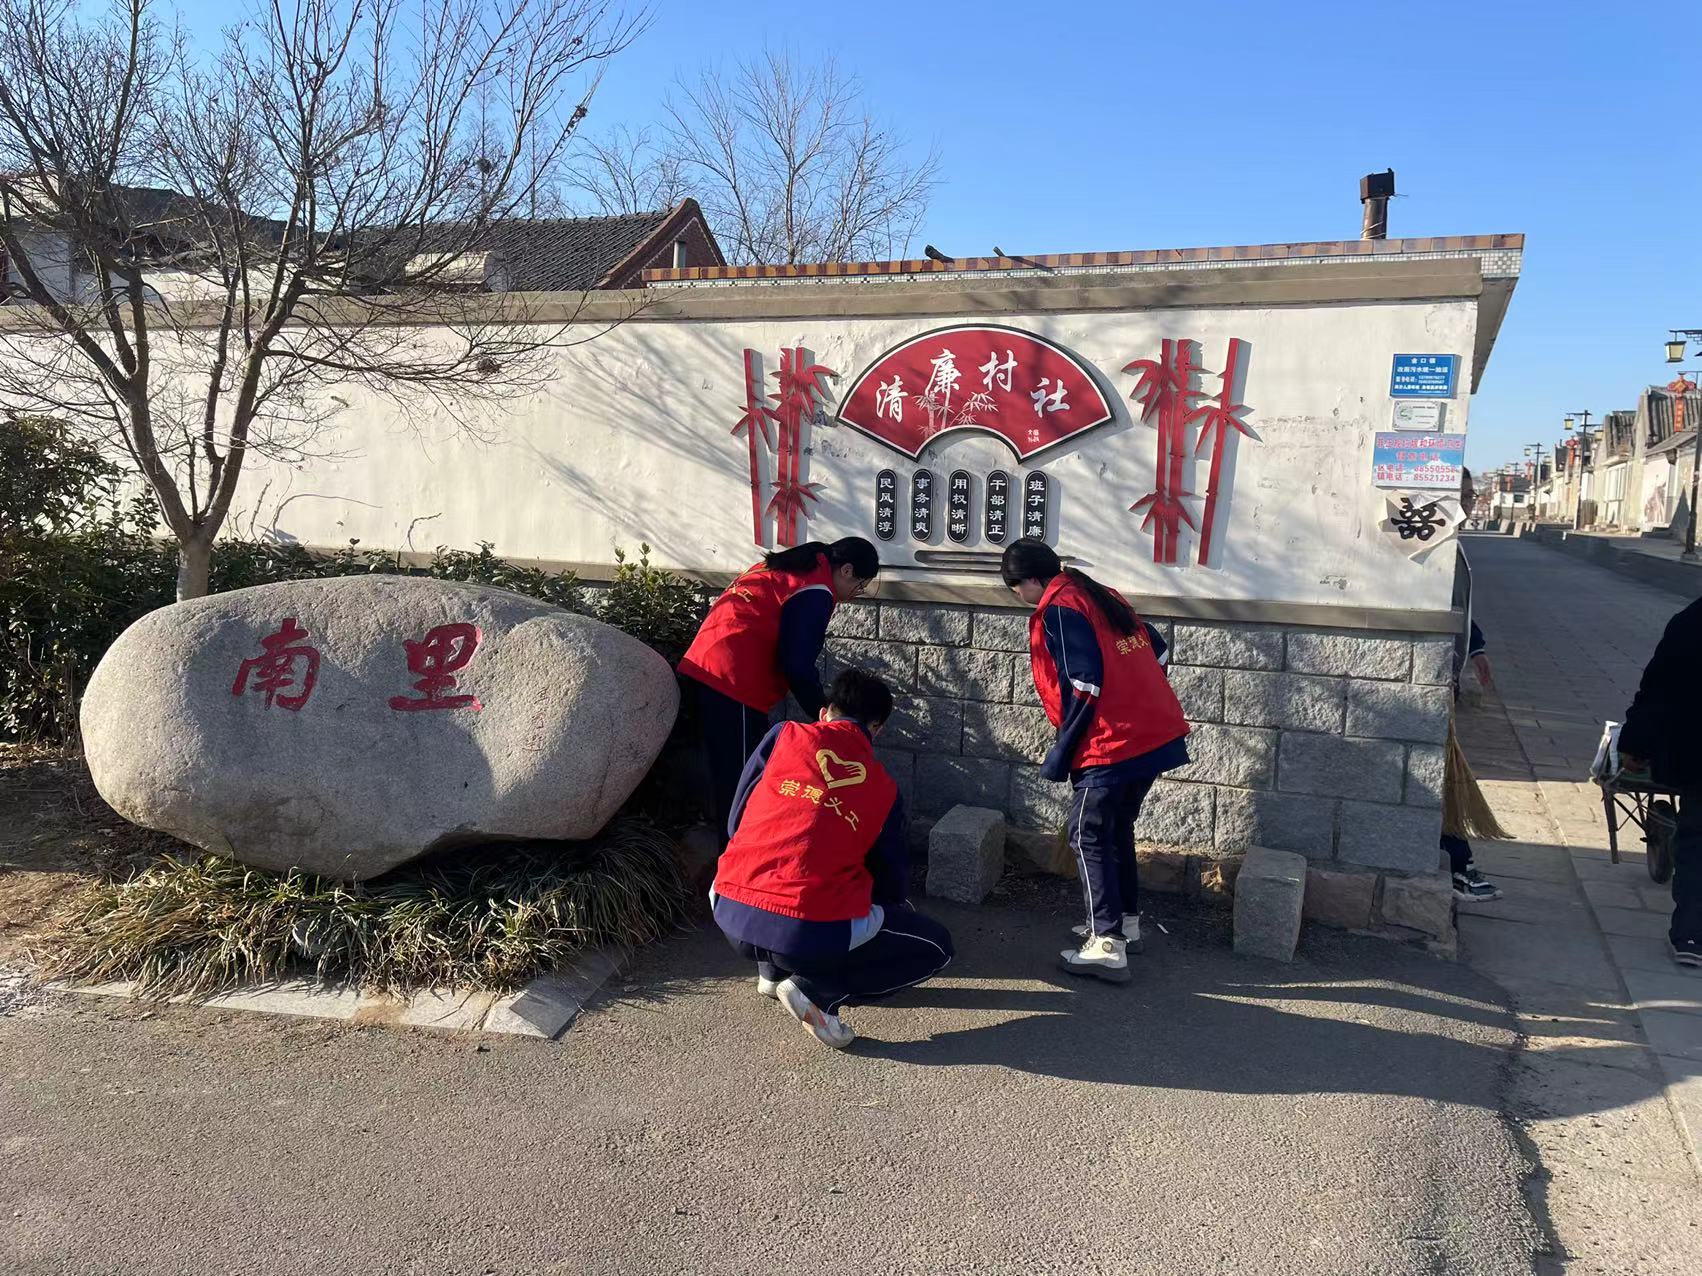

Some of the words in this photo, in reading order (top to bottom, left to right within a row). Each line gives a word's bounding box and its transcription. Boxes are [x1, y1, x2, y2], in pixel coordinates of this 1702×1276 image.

[875, 348, 1070, 424] 清廉村社
[878, 477, 894, 532] 民风清淳
[914, 478, 930, 533] 事务清爽
[951, 478, 967, 534] 用权清晰
[989, 479, 1006, 535] 干部清正
[1026, 479, 1045, 537] 班子清廉
[231, 617, 484, 712] 南里
